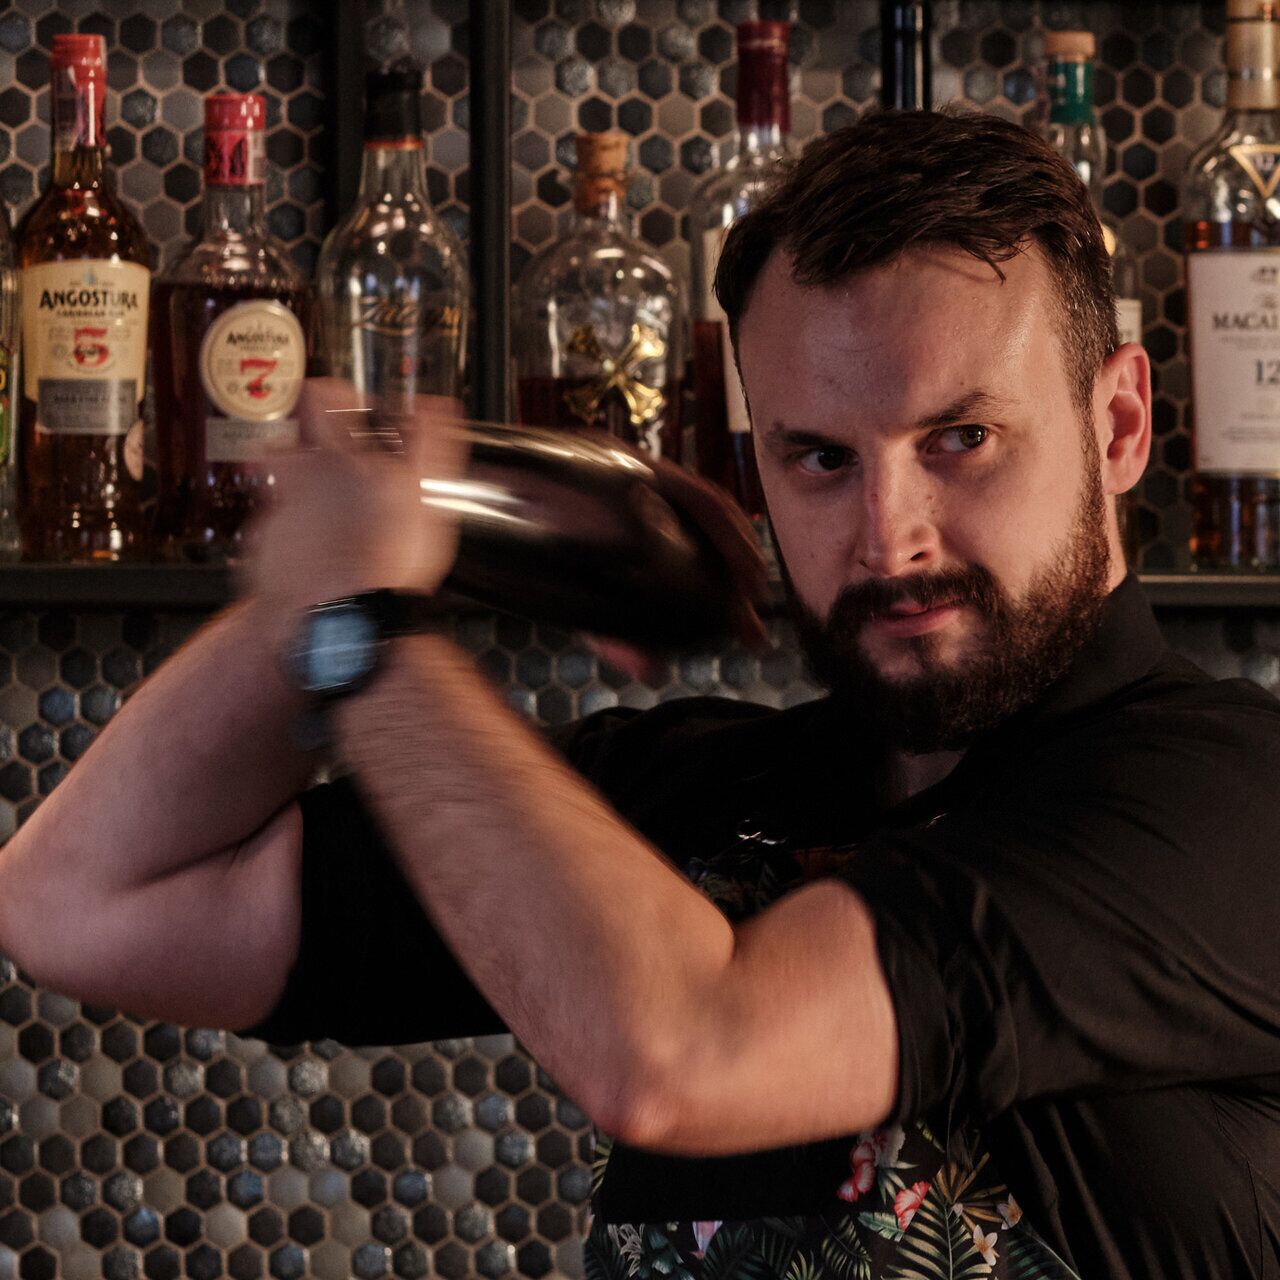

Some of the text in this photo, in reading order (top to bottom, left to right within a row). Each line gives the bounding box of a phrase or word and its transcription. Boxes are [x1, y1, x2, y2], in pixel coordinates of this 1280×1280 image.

[39, 288, 138, 310] ANGOSTURA
[73, 326, 109, 368] 5
[239, 358, 277, 400] 7
